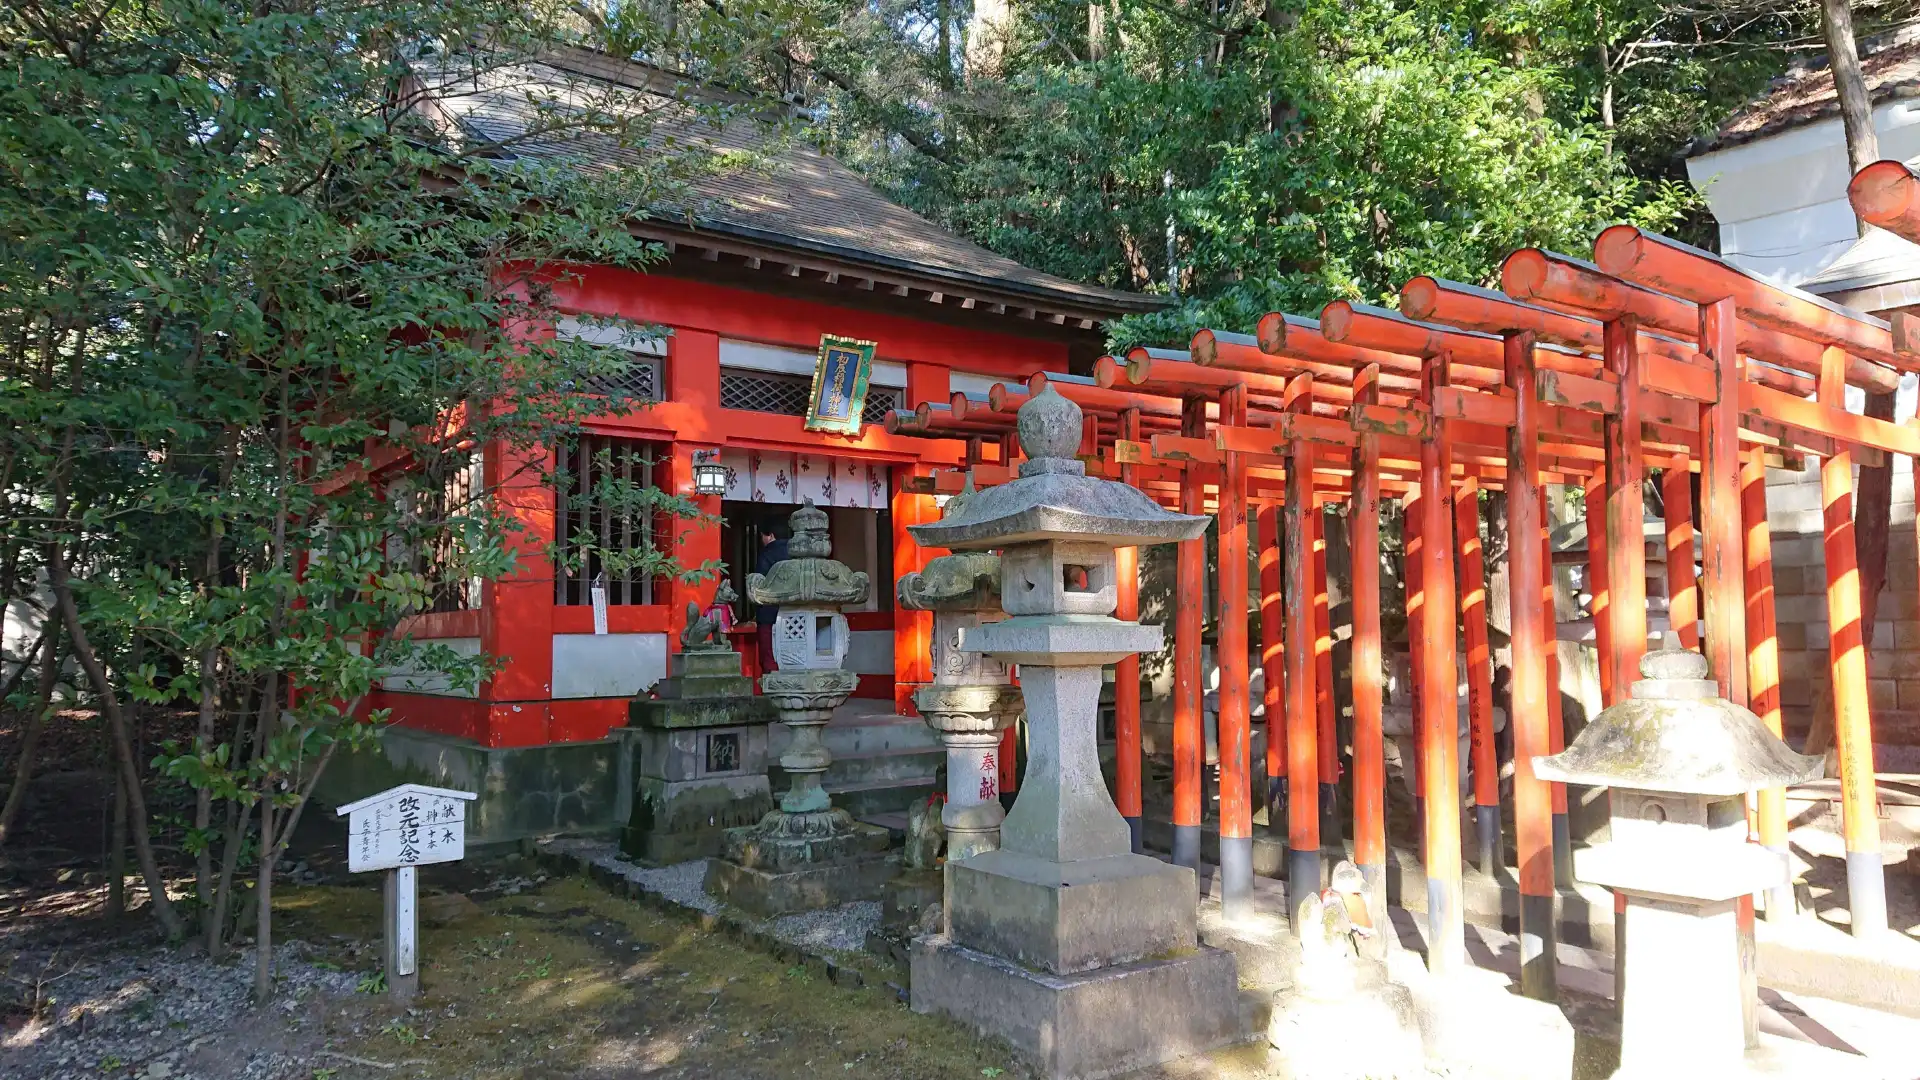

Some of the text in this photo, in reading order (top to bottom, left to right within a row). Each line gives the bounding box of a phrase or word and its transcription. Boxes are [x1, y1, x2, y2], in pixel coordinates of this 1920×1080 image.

[980, 752, 996, 800] 奉献
[398, 796, 421, 863] 改元記念
